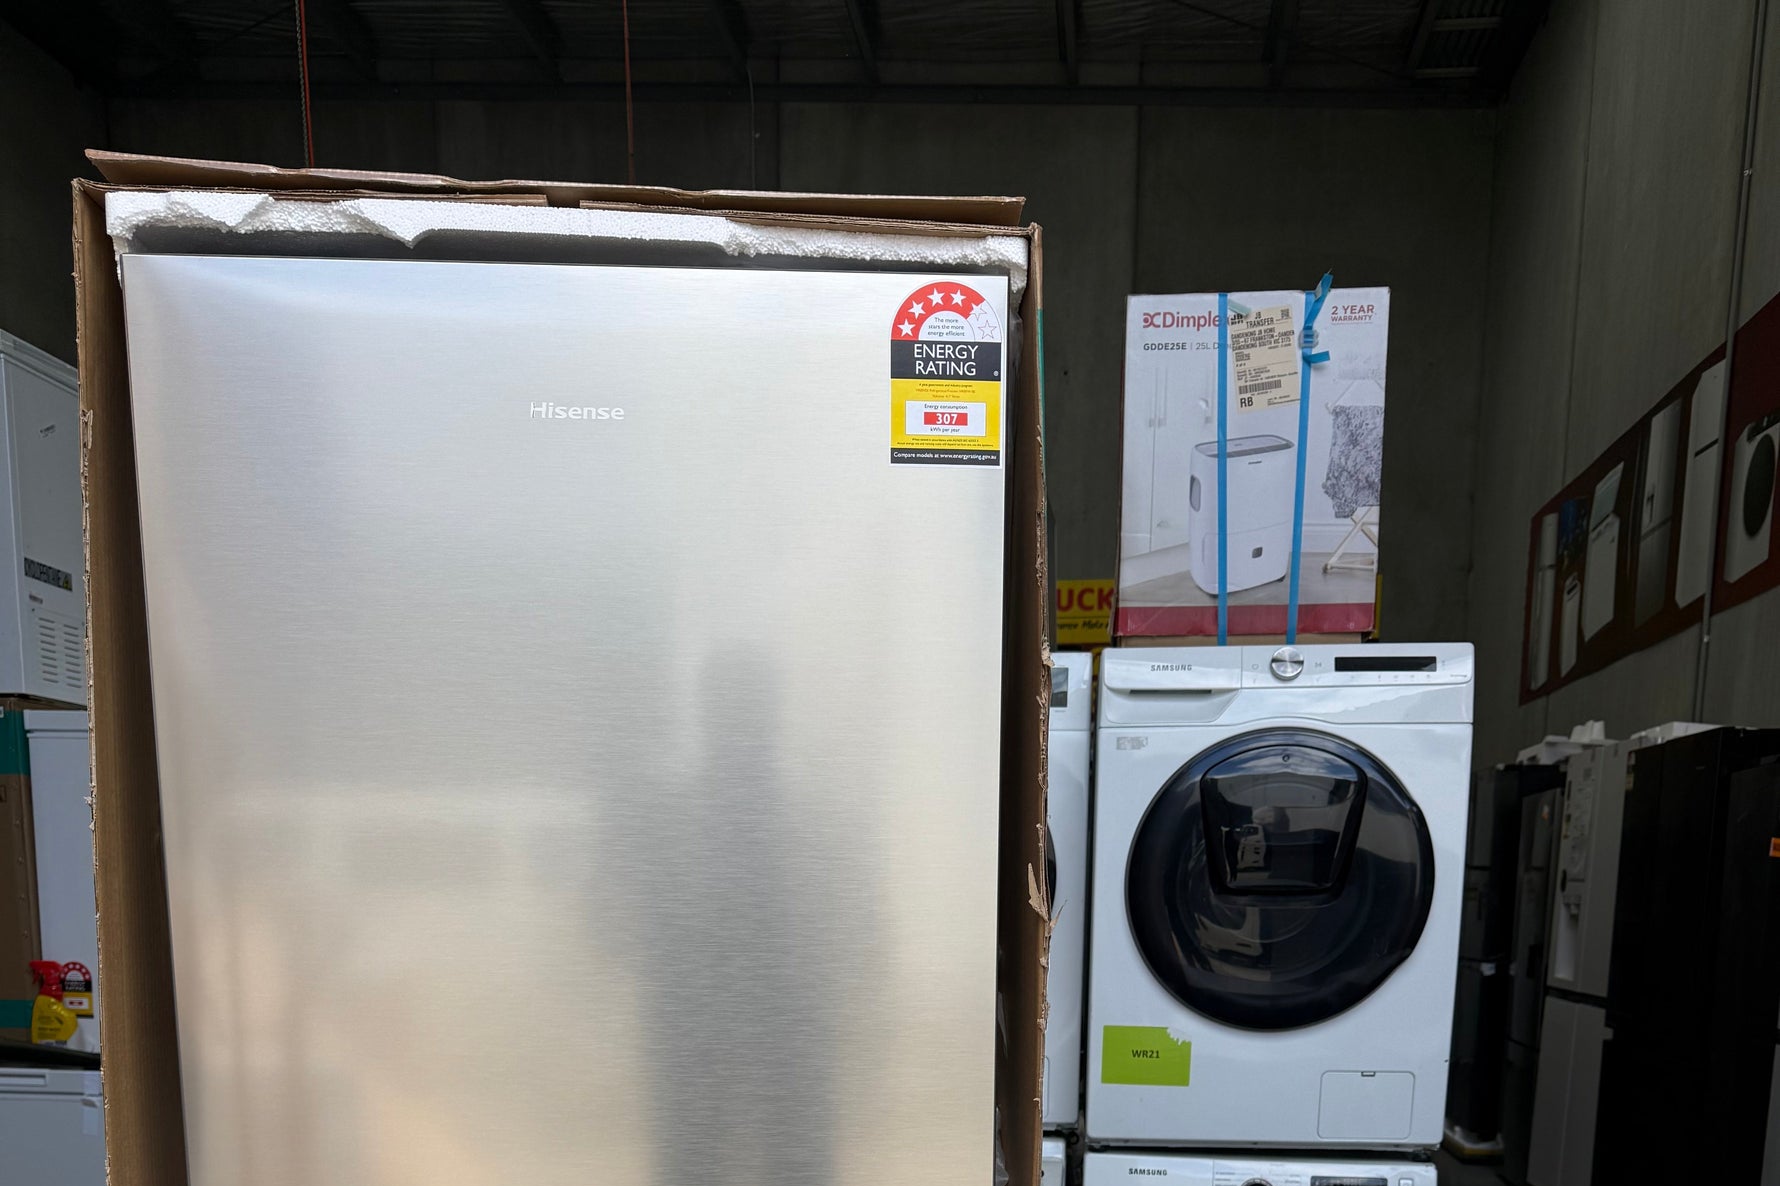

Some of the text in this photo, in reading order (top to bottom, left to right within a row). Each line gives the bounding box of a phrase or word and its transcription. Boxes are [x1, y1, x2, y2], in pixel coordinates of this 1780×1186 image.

[1331, 304, 1375, 316] 2 YEAR
[1162, 310, 1229, 332] Dimple
[1246, 317, 1274, 329] TRANSFER
[1331, 314, 1373, 322] WARRANTY
[914, 343, 978, 360] ENERGY
[1143, 342, 1187, 350] GDDE25E
[1196, 342, 1211, 350] 25L
[916, 360, 976, 376] RATING
[1240, 396, 1254, 408] RB
[530, 401, 624, 420] Hisense
[936, 414, 958, 424] 307
[1150, 664, 1192, 672] SAMSUNG
[1132, 1049, 1160, 1060] WR21
[1128, 1168, 1168, 1176] SAMSUNG
